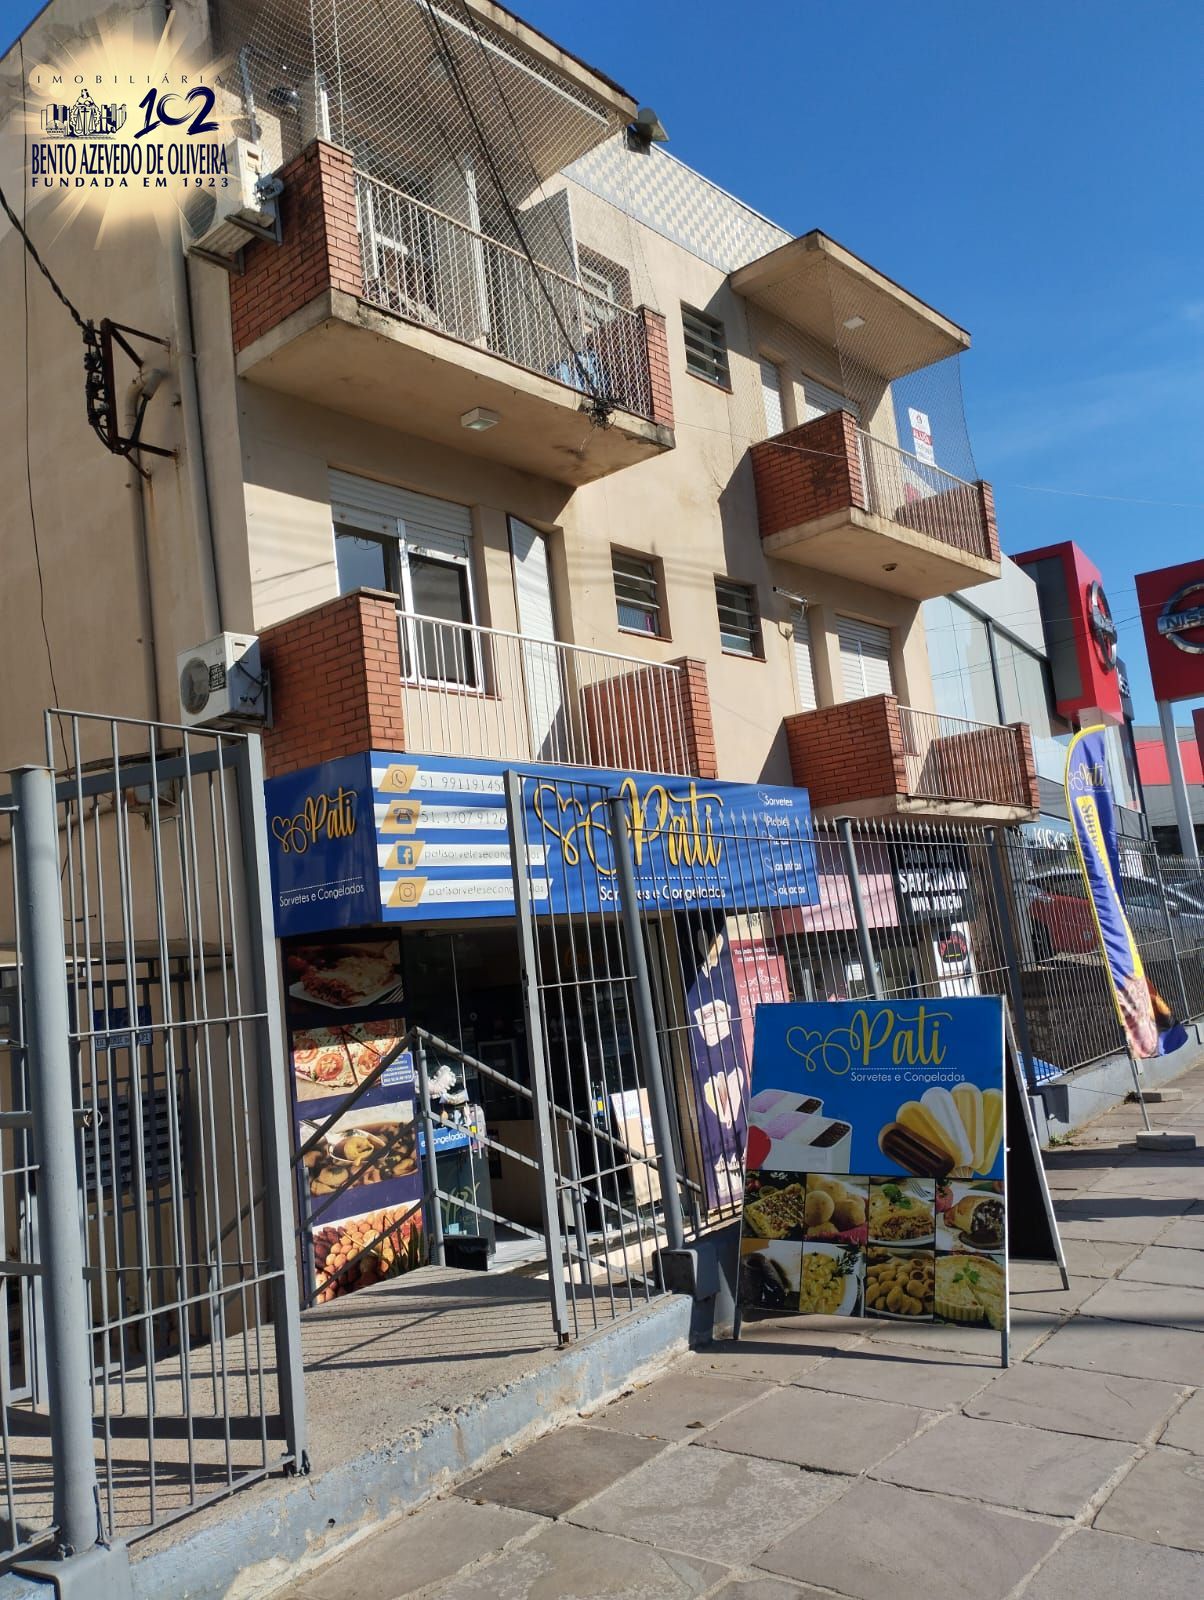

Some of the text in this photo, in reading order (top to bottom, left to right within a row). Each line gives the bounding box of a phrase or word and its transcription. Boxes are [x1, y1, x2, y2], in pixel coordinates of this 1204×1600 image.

[300, 786, 357, 844] Pati
[616, 777, 724, 867] Pati
[279, 883, 365, 907] Sorvetes e Congelados
[600, 886, 650, 900] Sores
[850, 1005, 952, 1066] Pati
[851, 1071, 965, 1083] Sorvetes e Congelados
[432, 1131, 466, 1145] ongelados
